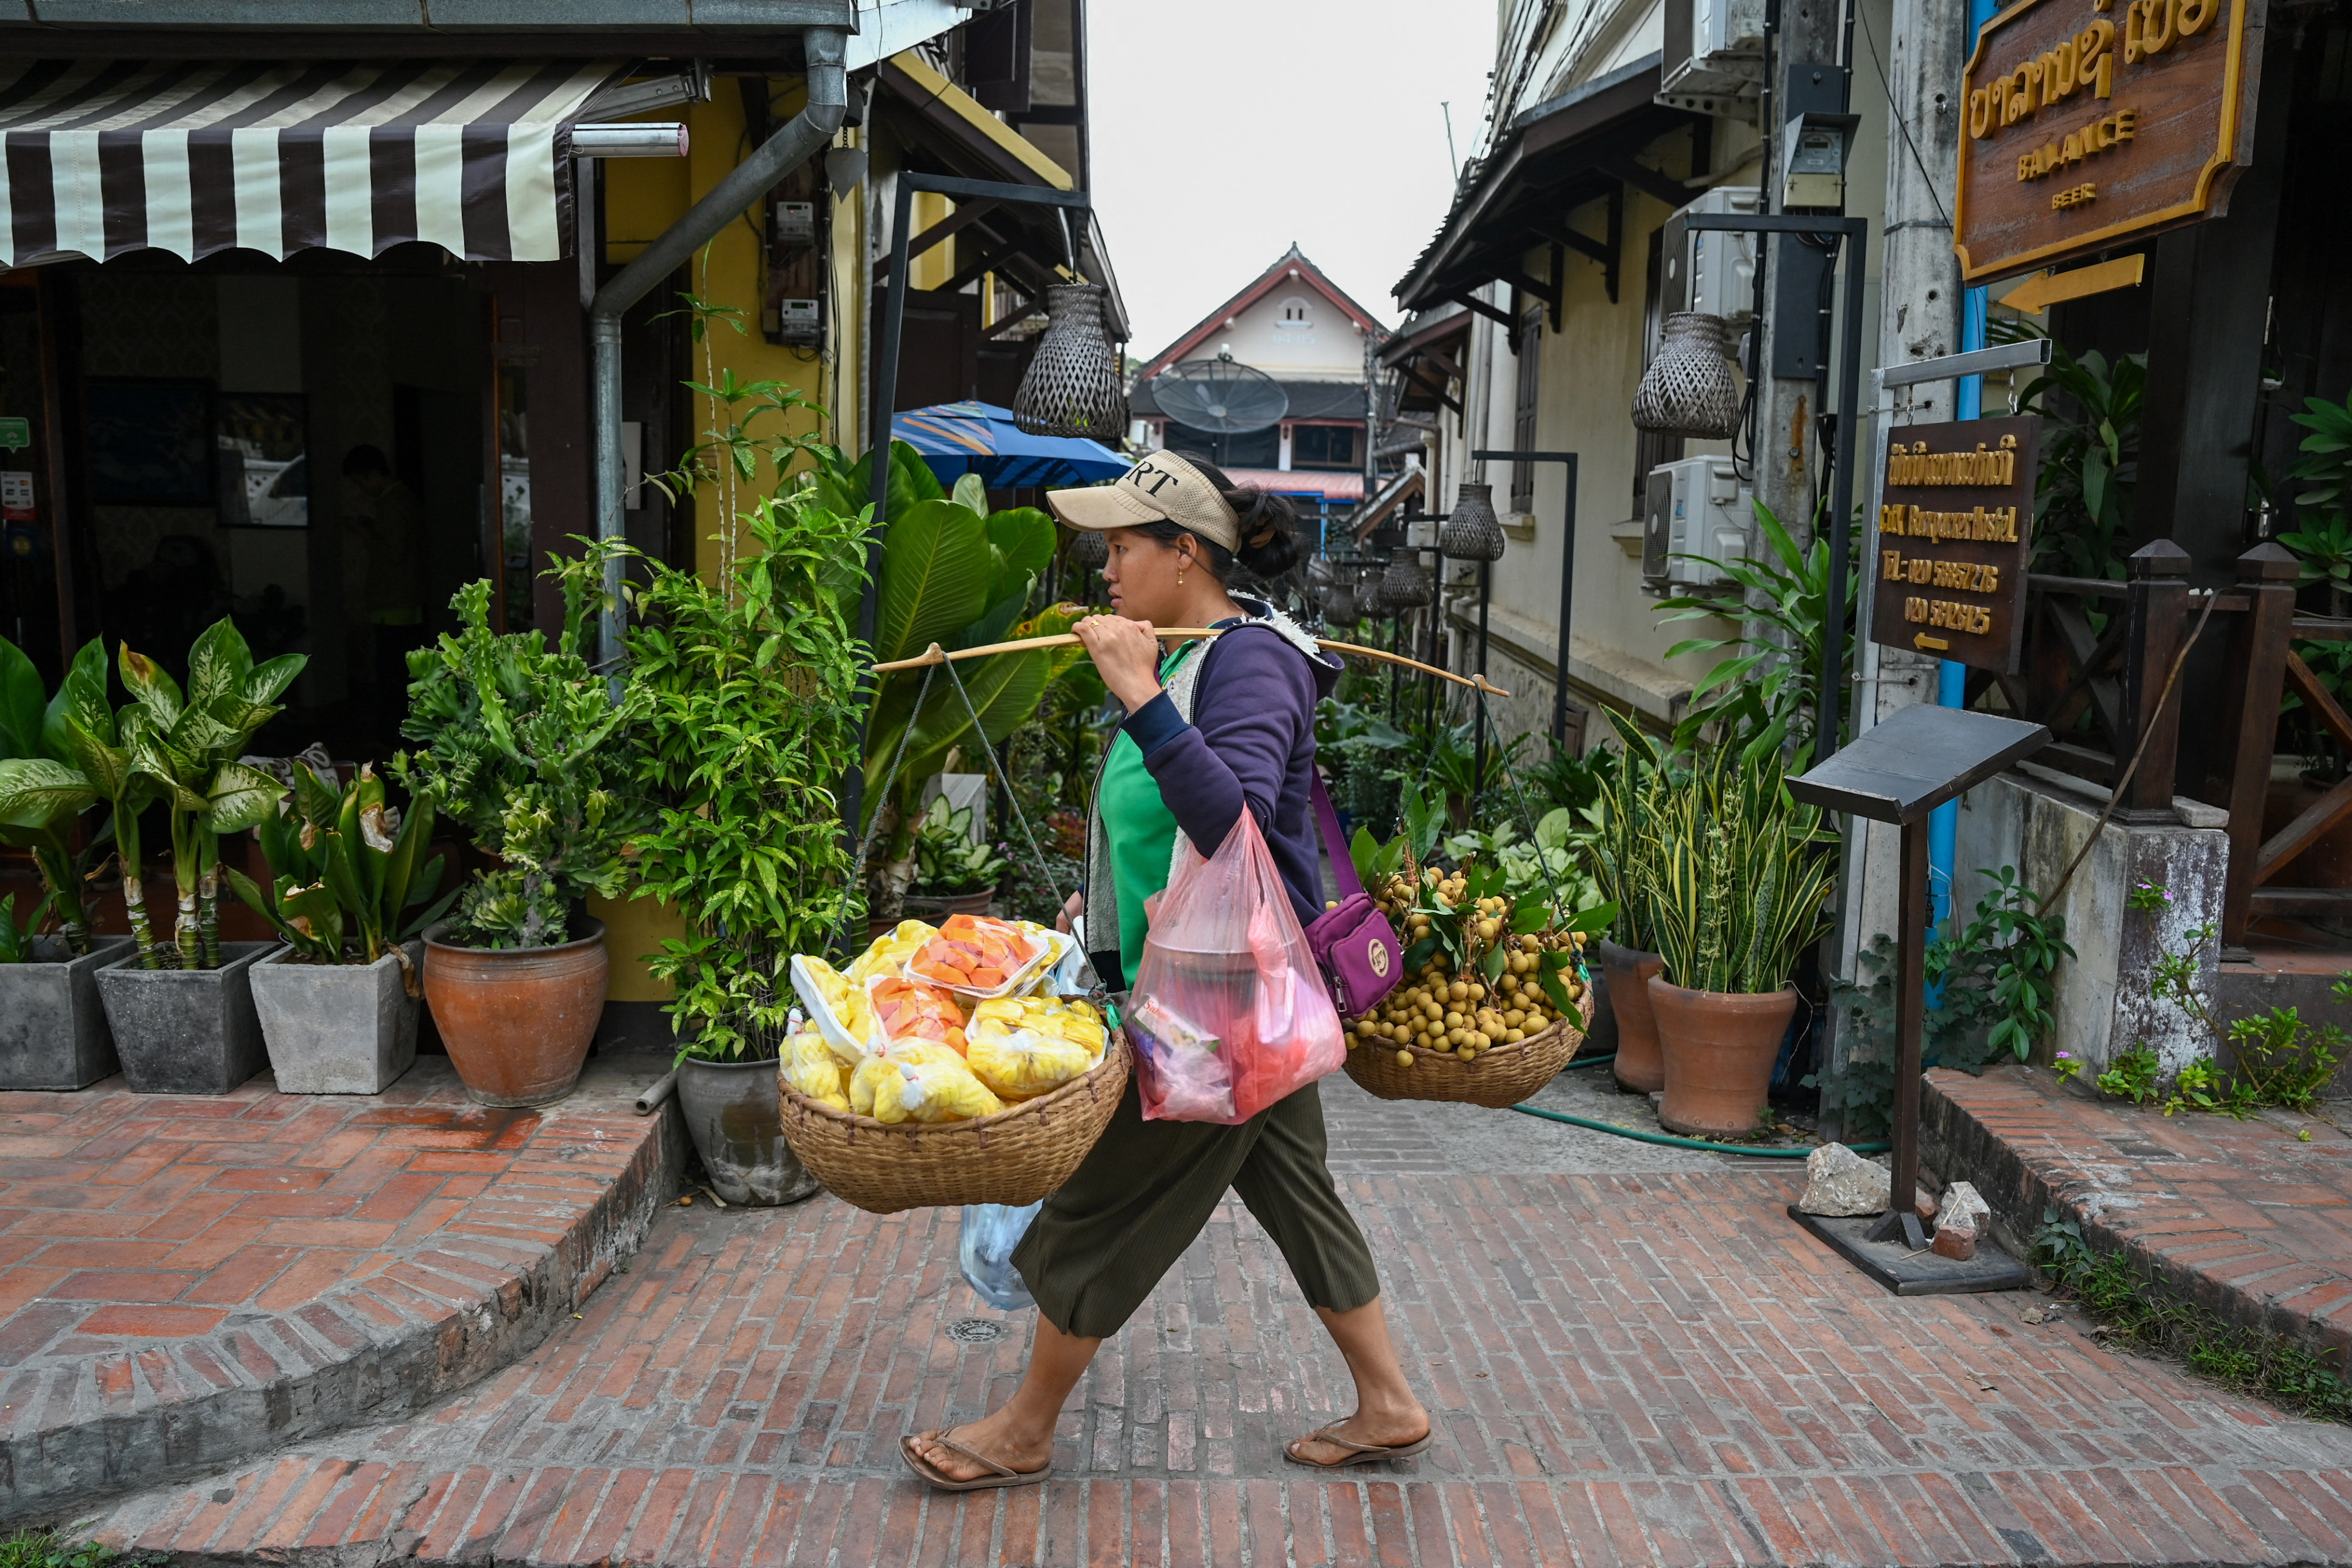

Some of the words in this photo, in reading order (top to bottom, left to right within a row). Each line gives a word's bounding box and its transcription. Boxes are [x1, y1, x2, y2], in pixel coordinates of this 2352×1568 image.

[2017, 108, 2137, 181] BALANCE
[2052, 183, 2097, 210] BEER
[1908, 505, 1972, 544] Backpacker
[1905, 597, 1928, 623] 020
